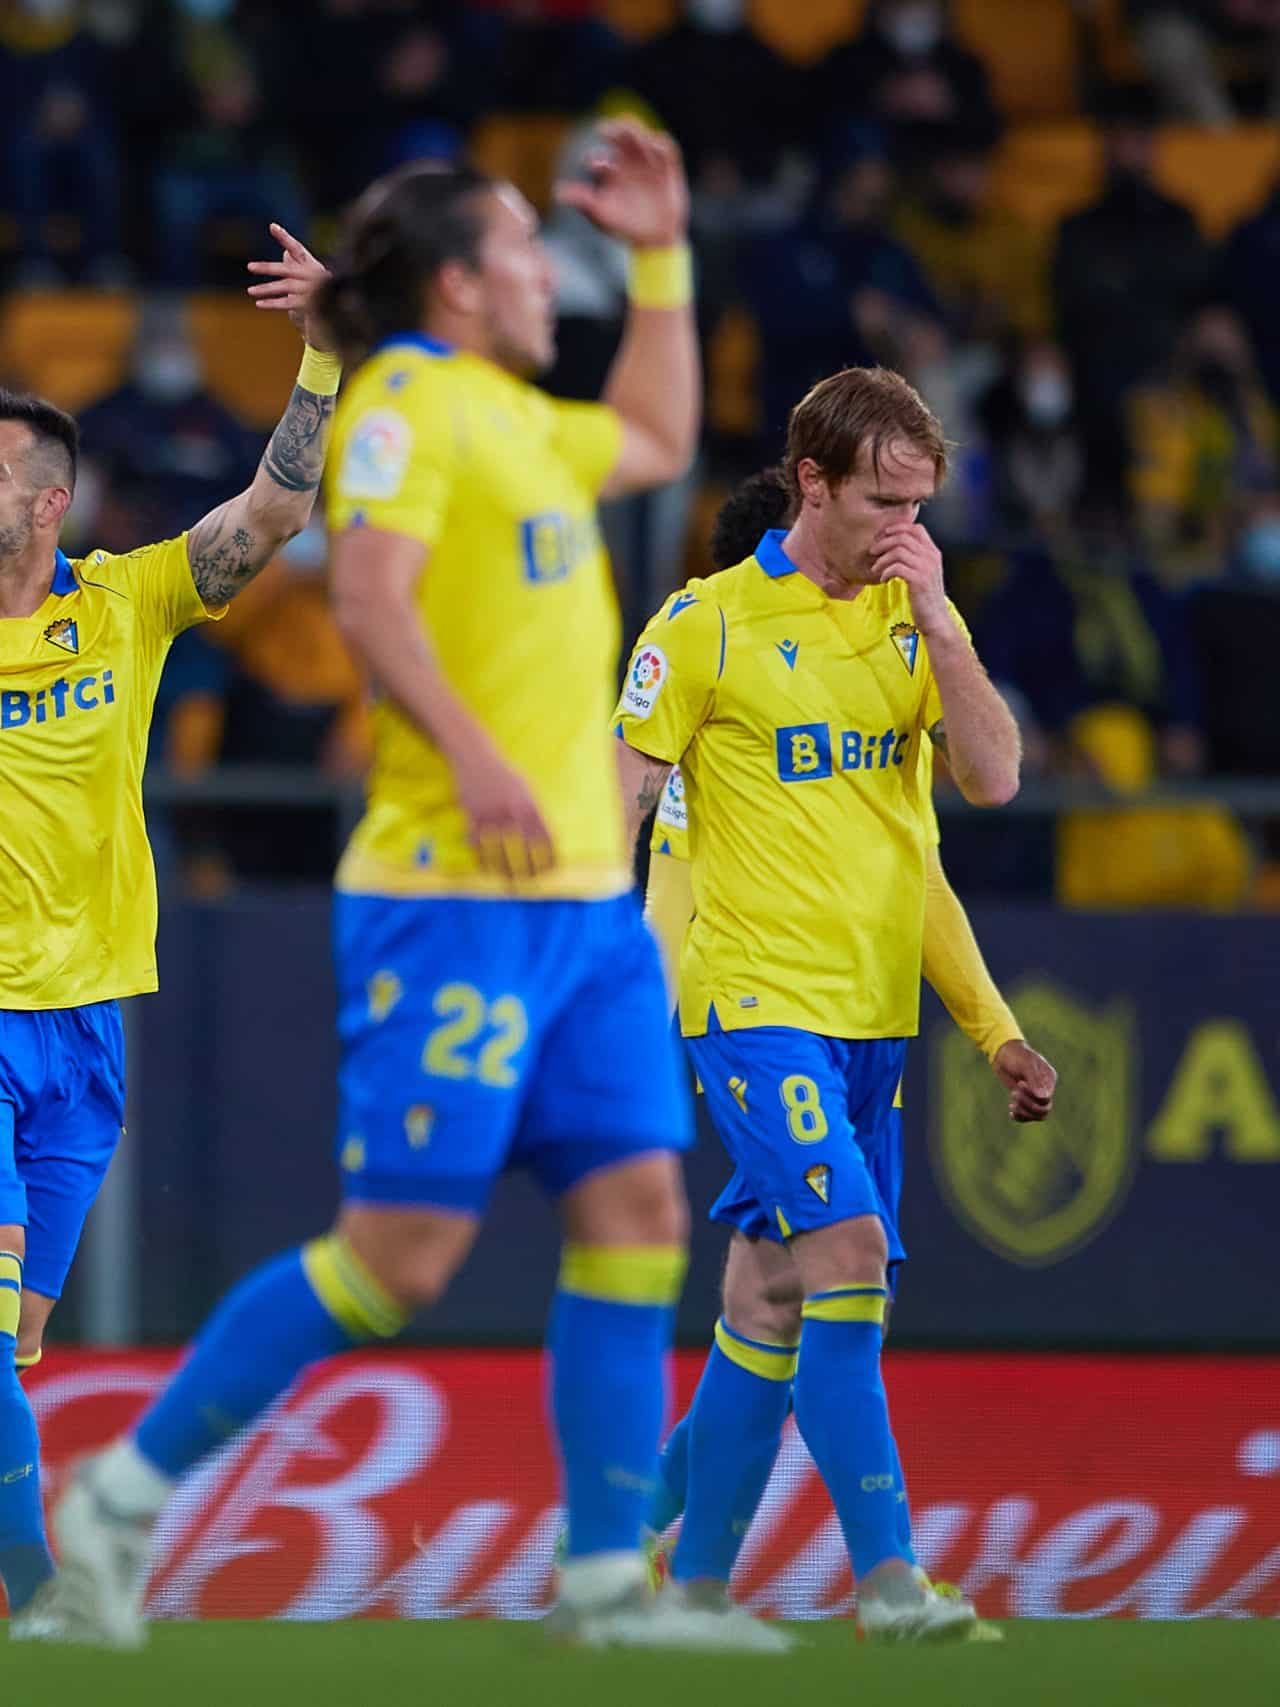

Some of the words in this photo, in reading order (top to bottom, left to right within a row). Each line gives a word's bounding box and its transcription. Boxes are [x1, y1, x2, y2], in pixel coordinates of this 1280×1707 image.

[1, 670, 115, 730] Bitci
[421, 982, 529, 1089] 22
[779, 1074, 829, 1146] 8
